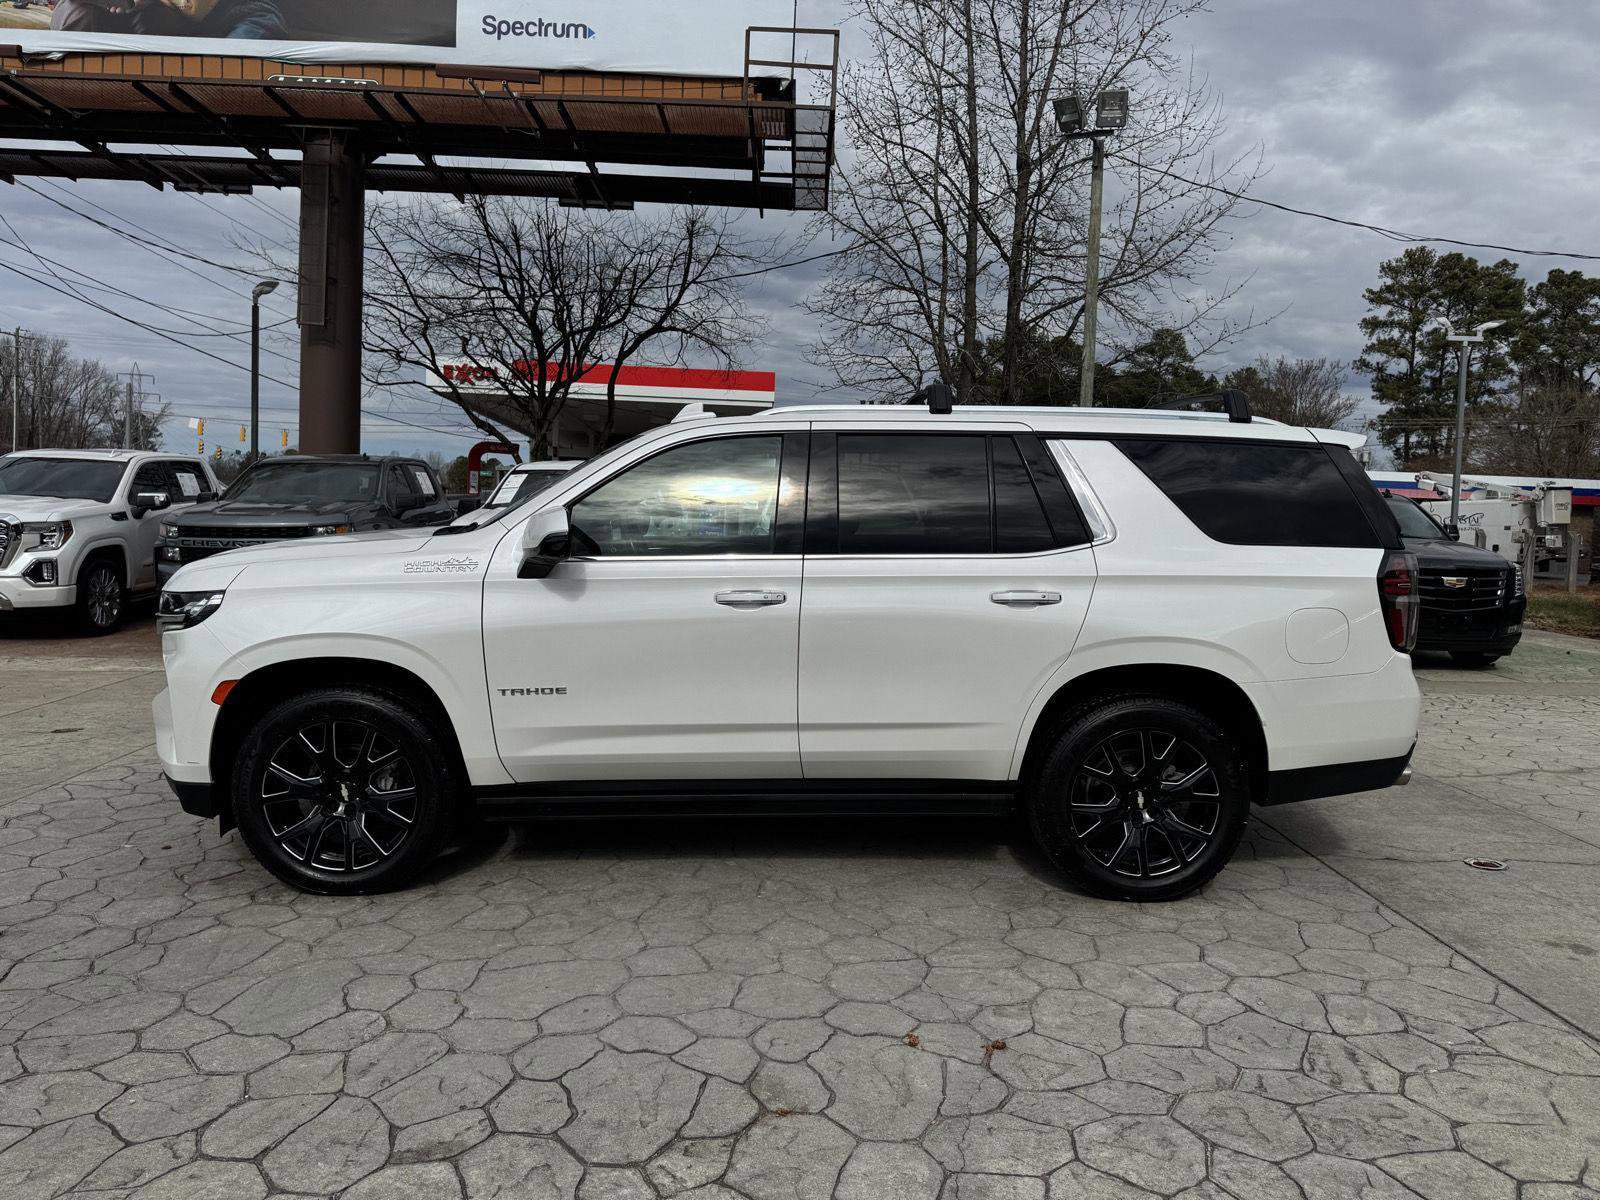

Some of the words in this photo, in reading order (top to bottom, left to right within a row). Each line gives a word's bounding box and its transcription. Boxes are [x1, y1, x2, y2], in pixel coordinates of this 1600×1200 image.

[481, 14, 588, 40] Spectrum
[404, 565, 479, 573] COUNTRY
[497, 687, 567, 696] TAHOE
